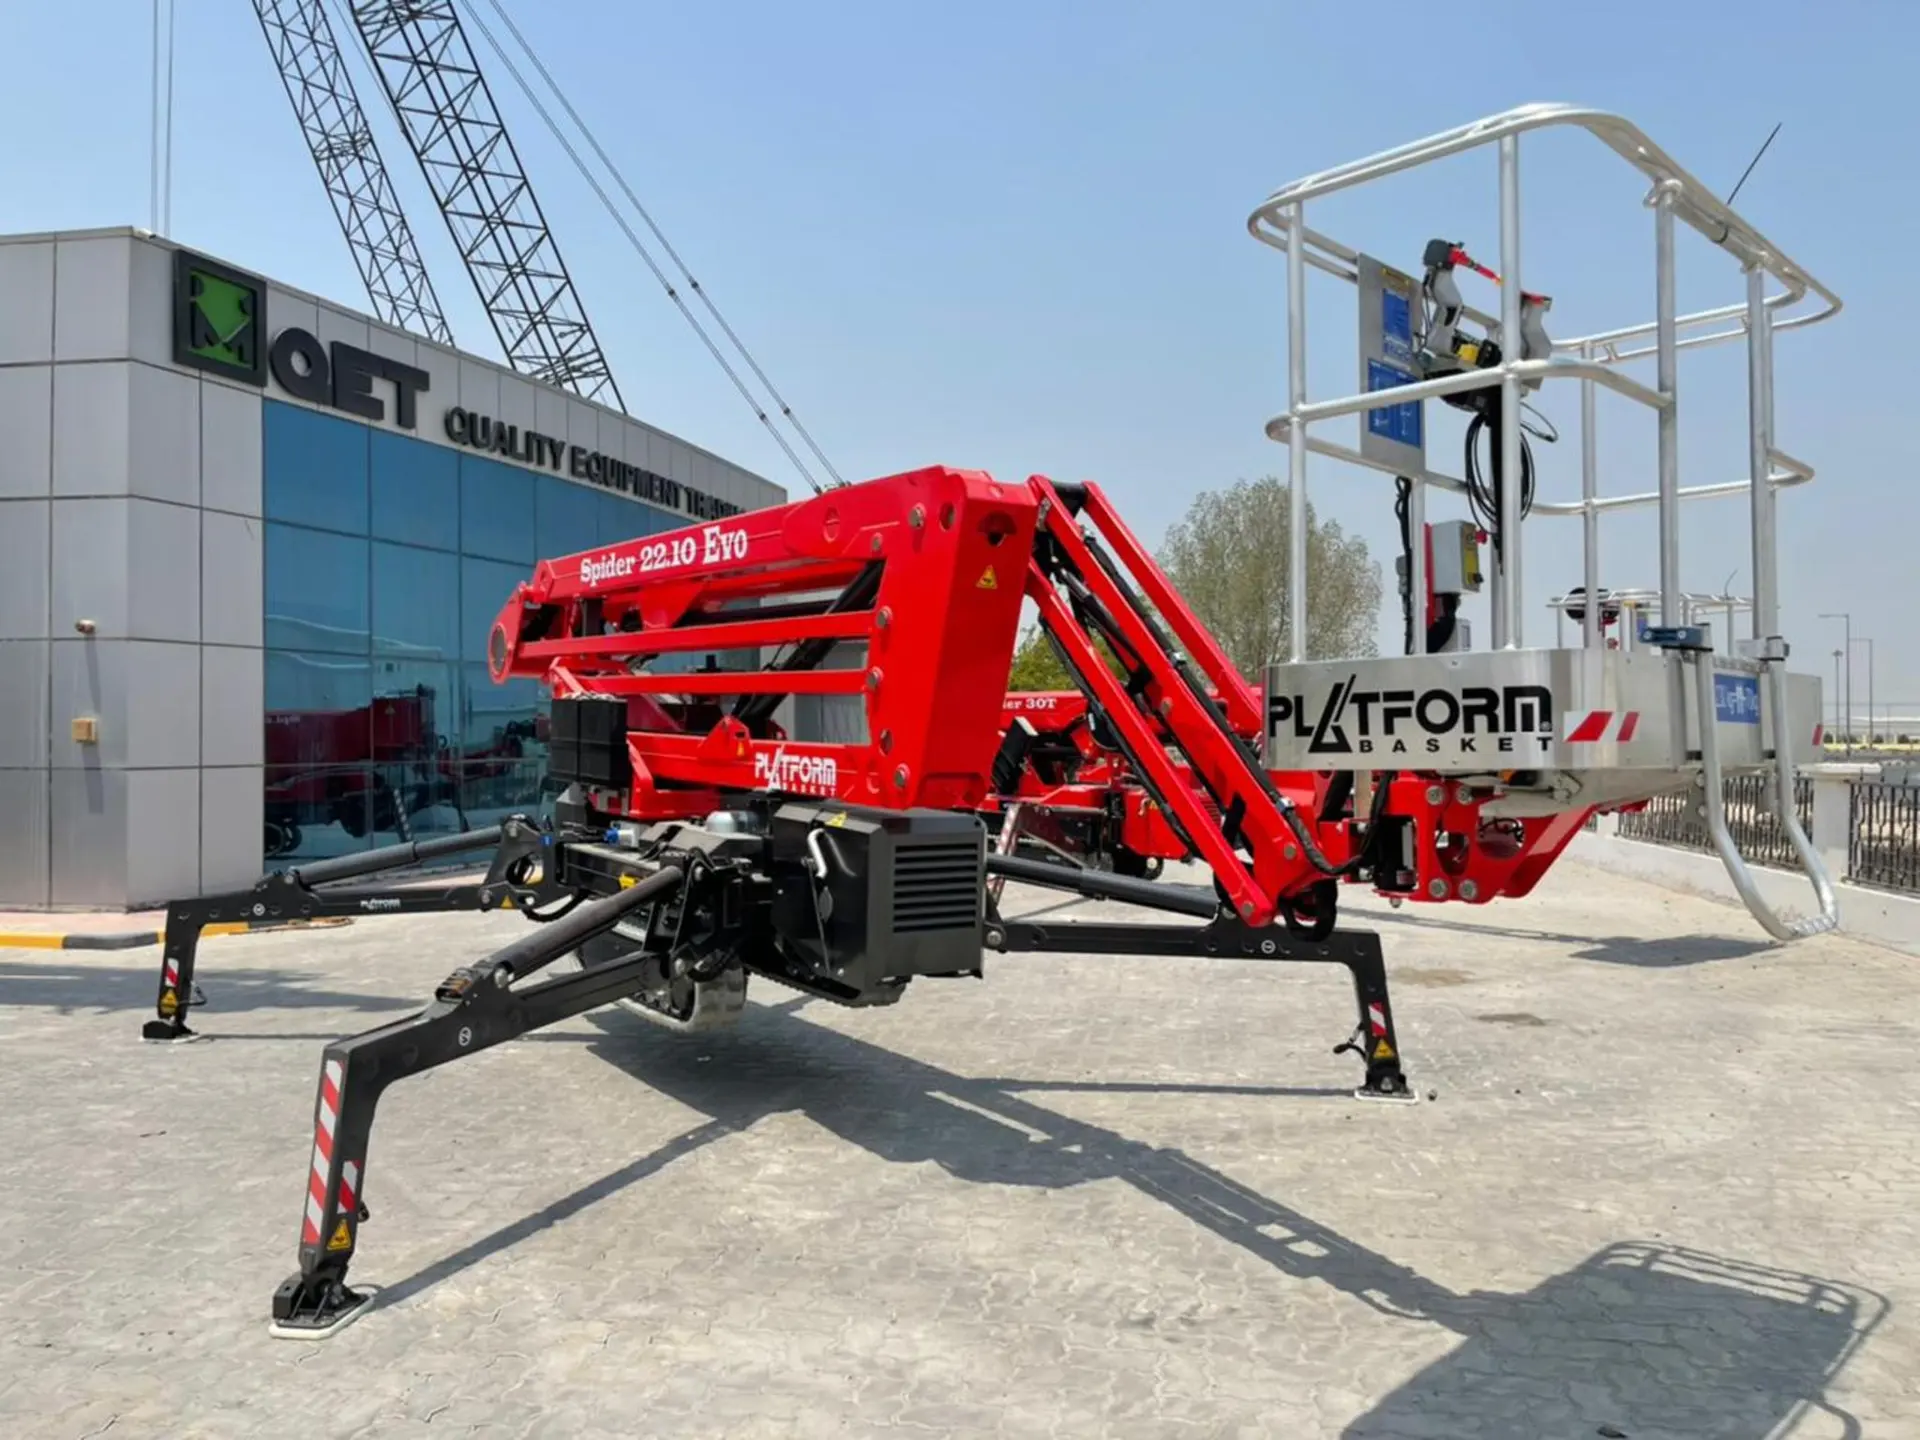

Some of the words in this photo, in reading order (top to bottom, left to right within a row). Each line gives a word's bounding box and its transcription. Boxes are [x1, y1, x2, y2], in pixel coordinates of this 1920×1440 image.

[269, 327, 430, 429] QET
[444, 406, 567, 471] QUALITY
[570, 445, 683, 509] EQUIPMENT
[580, 552, 636, 587] Spider
[640, 537, 697, 572] 22.10
[702, 525, 748, 565] Evo
[1268, 674, 1553, 753] PLATFORM
[1359, 736, 1553, 753] BASKET
